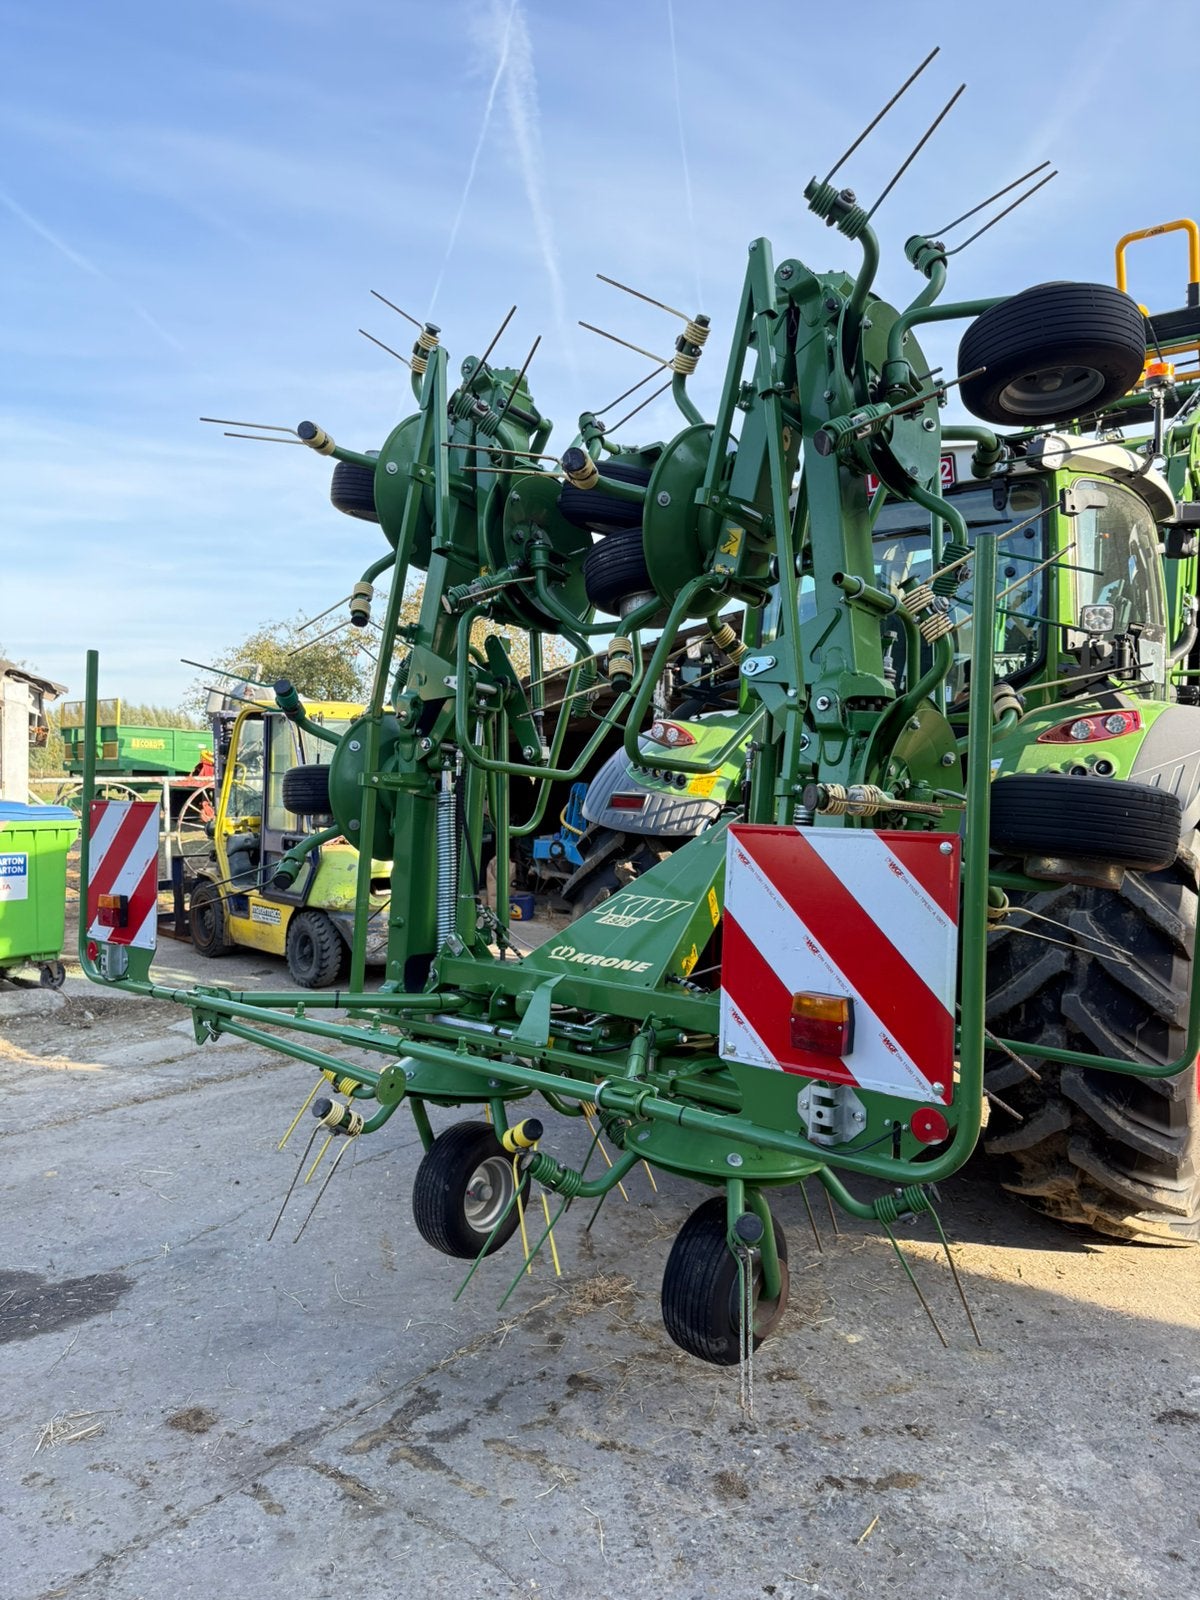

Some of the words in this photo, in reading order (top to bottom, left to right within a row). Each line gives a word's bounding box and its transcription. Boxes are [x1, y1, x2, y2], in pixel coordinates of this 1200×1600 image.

[737, 851, 750, 866] WGF
[888, 861, 904, 878] WGF
[592, 893, 695, 923] KW
[806, 939, 820, 956] WGF
[568, 952, 654, 973] KRONE
[732, 1011, 745, 1027] WGF
[882, 1037, 898, 1055] WGF
